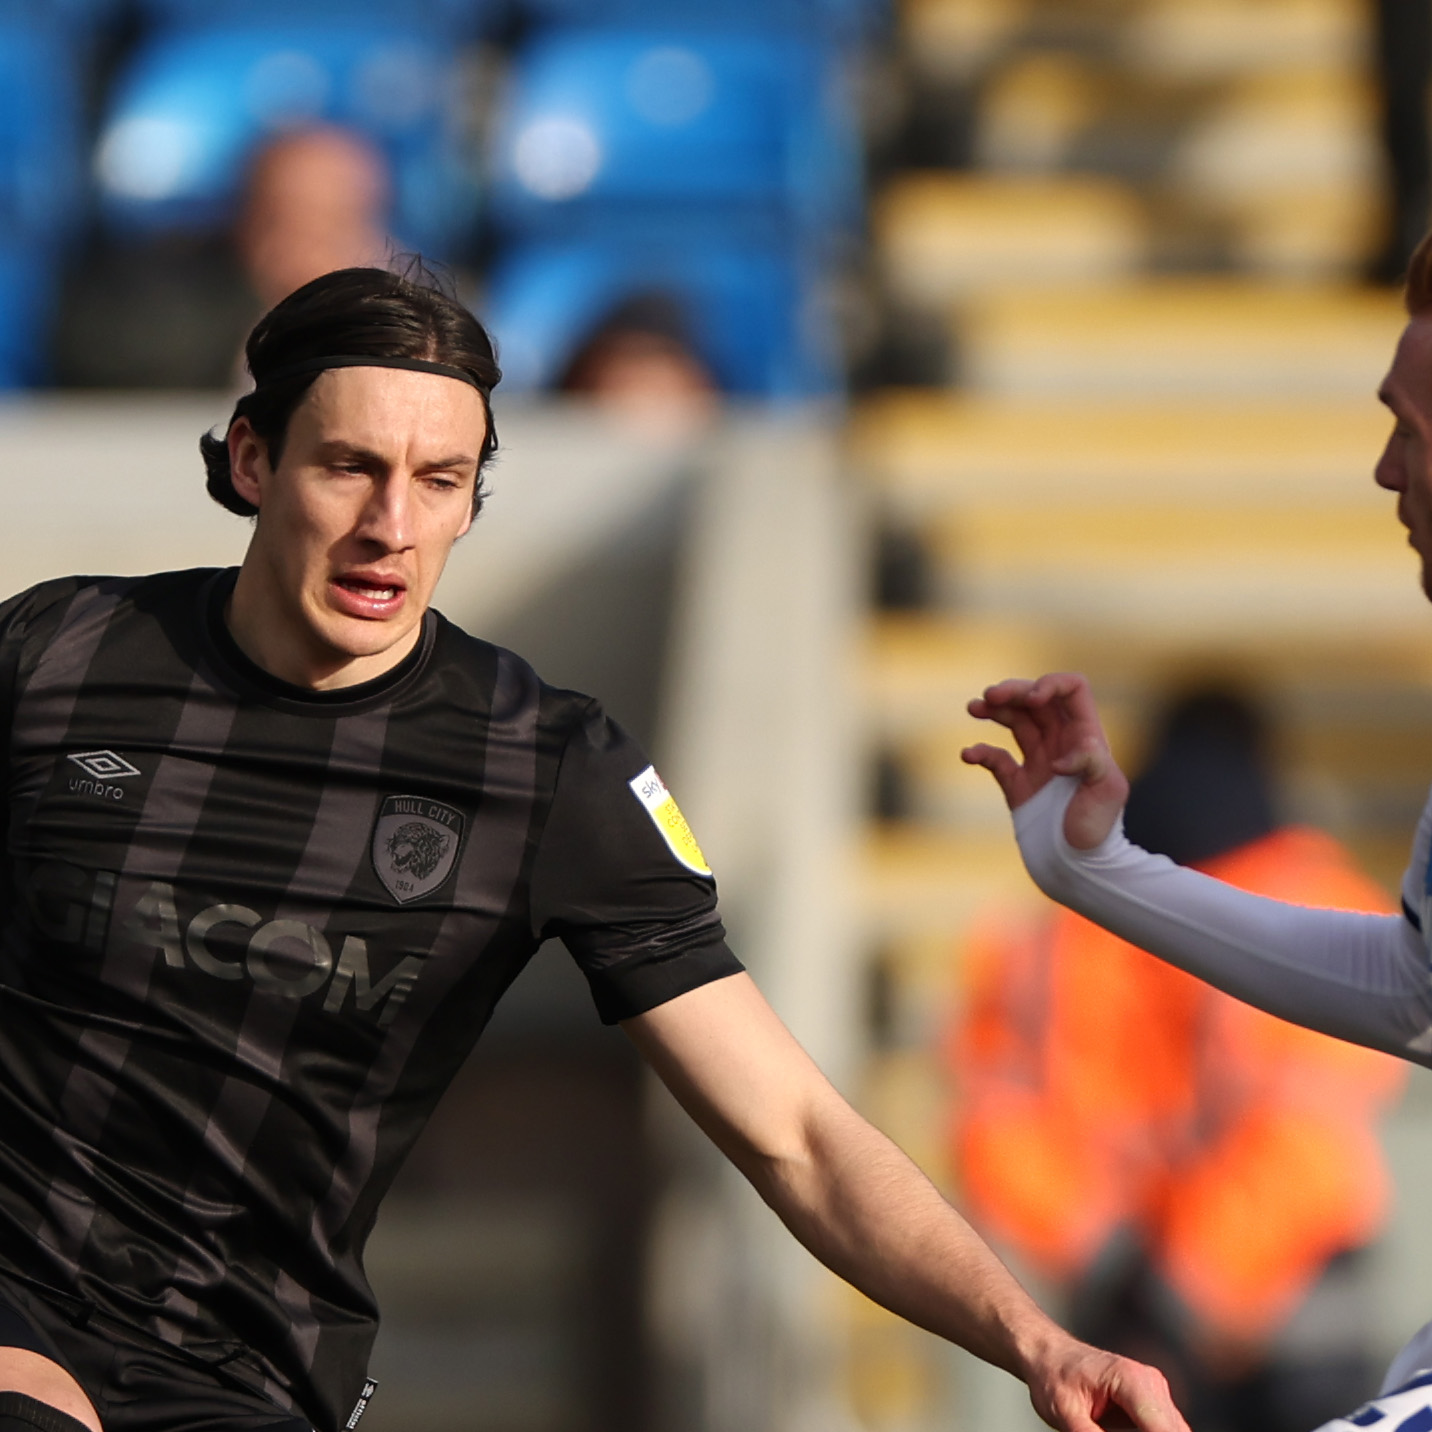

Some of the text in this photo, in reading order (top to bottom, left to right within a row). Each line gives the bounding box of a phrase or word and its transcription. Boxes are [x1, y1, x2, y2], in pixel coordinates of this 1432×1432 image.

[69, 778, 124, 800] umbro
[641, 779, 662, 799] sky
[394, 800, 456, 825] HULL CITY
[394, 880, 415, 894] 1904
[27, 860, 427, 1029] GIACOM
